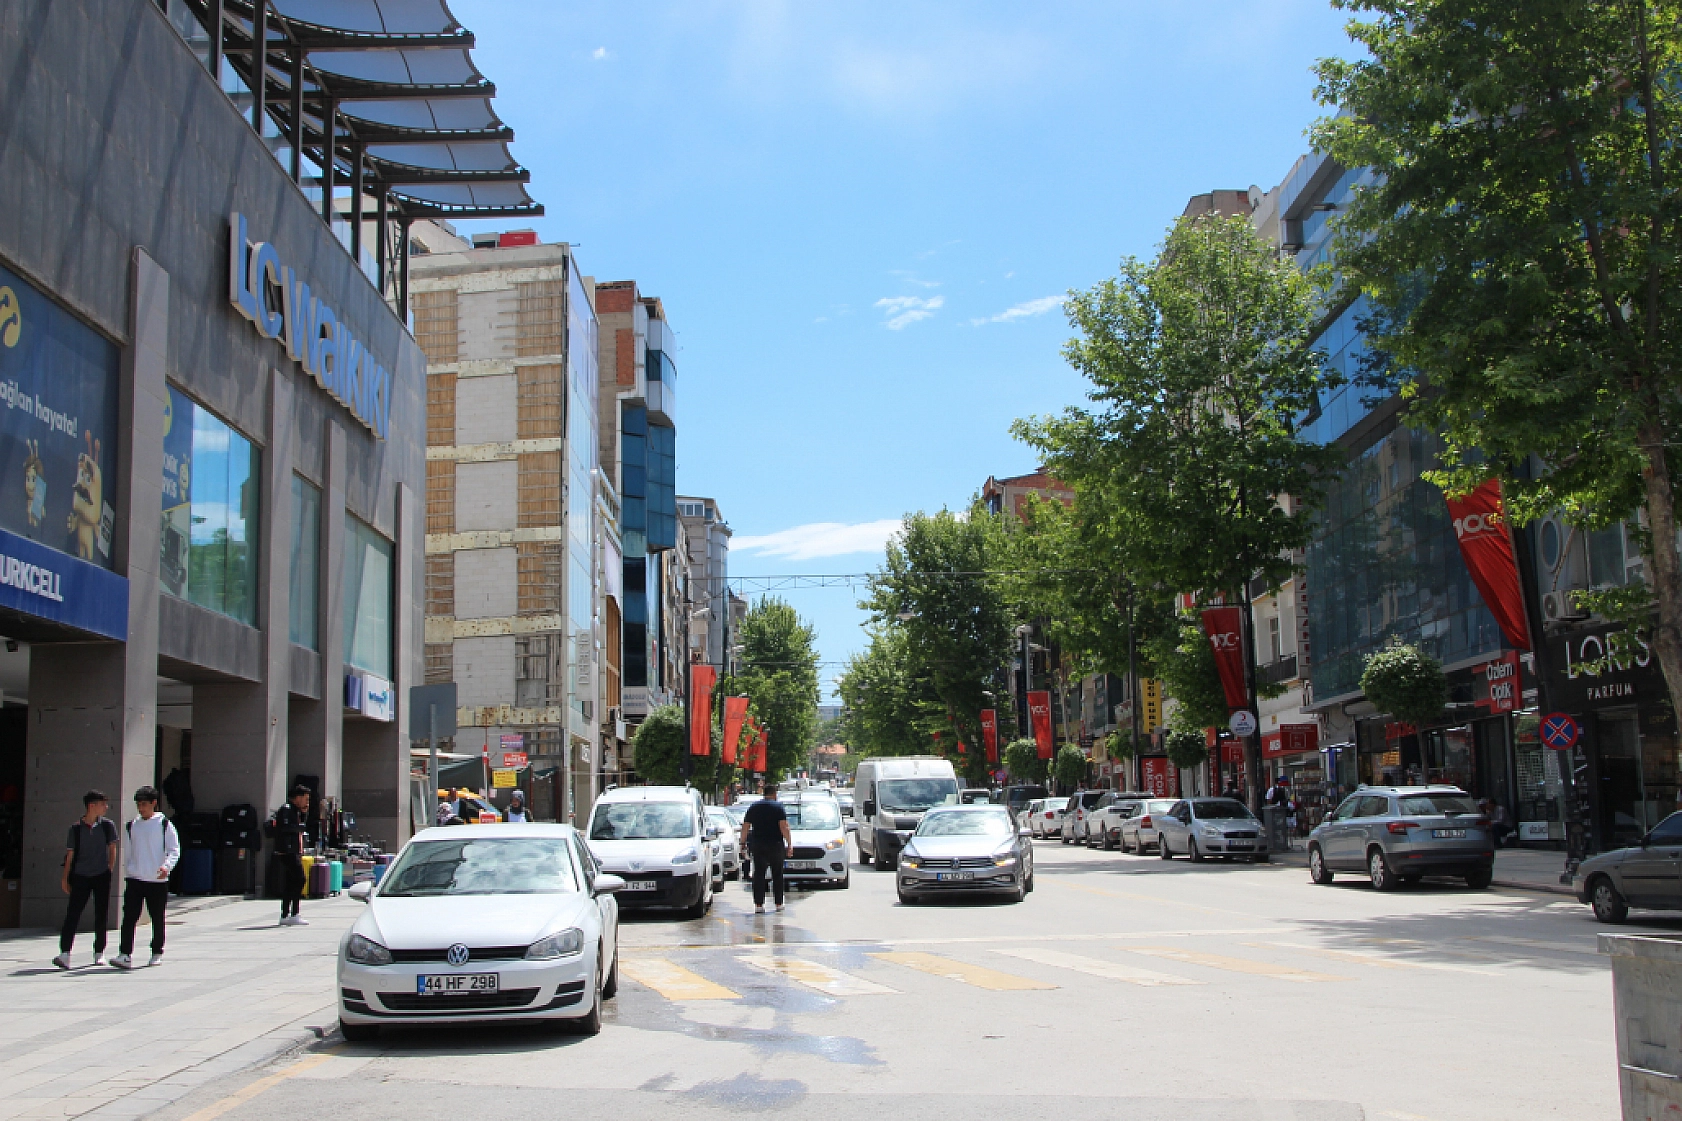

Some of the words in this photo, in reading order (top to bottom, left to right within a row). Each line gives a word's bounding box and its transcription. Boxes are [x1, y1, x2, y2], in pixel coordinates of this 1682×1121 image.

[1586, 683, 1633, 701] PARFUM
[425, 976, 442, 991] 44
[445, 976, 467, 990] HF
[470, 975, 497, 990] 298
